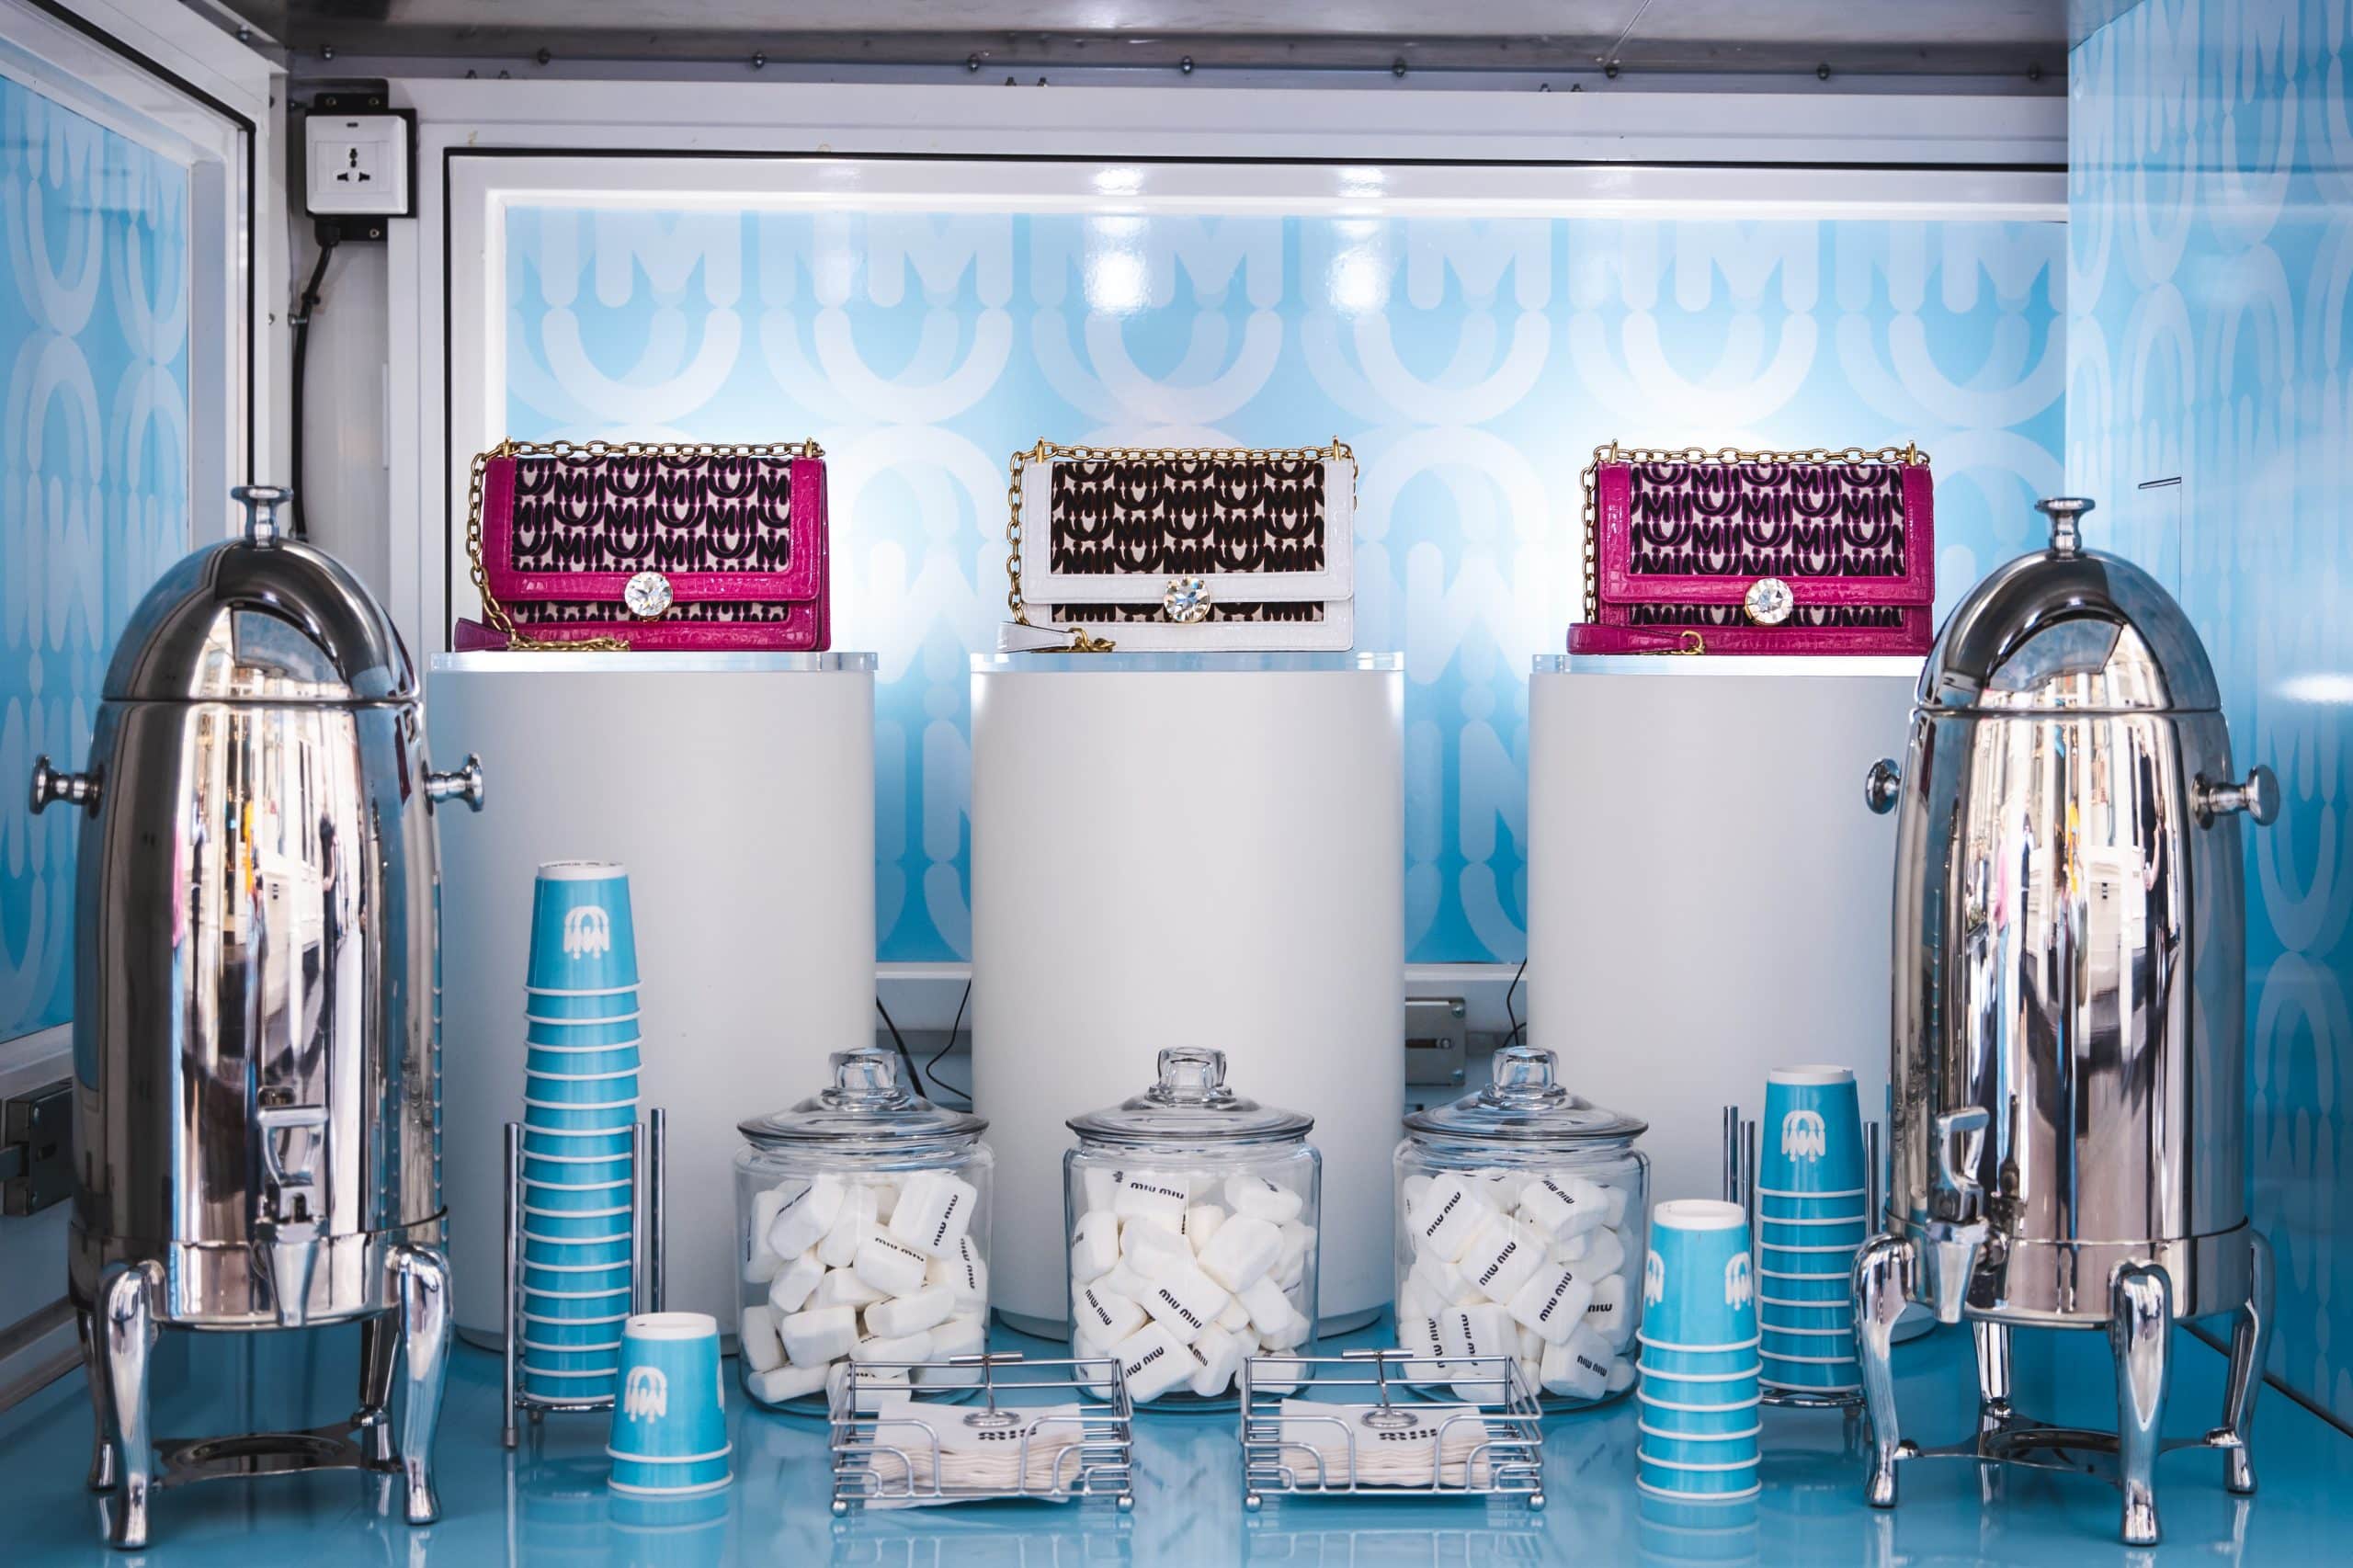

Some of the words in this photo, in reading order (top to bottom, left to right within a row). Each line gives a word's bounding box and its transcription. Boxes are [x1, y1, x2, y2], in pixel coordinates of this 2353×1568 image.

[1131, 1181, 1156, 1193] miu
[1158, 1187, 1185, 1199] miu
[944, 1194, 959, 1220] miu
[1444, 1191, 1461, 1214] miu
[933, 1221, 947, 1246] miu
[1427, 1213, 1444, 1237] miu
[1496, 1241, 1517, 1265] miu
[1479, 1263, 1499, 1286] miu
[1085, 1289, 1099, 1309] miu
[1158, 1288, 1180, 1310] miu
[1179, 1308, 1202, 1329] miu
[1539, 1297, 1558, 1322] miu
[1554, 1271, 1573, 1297] miu
[1096, 1306, 1113, 1326] miu
[1460, 1313, 1472, 1339] miu
[1142, 1346, 1165, 1366] miu
